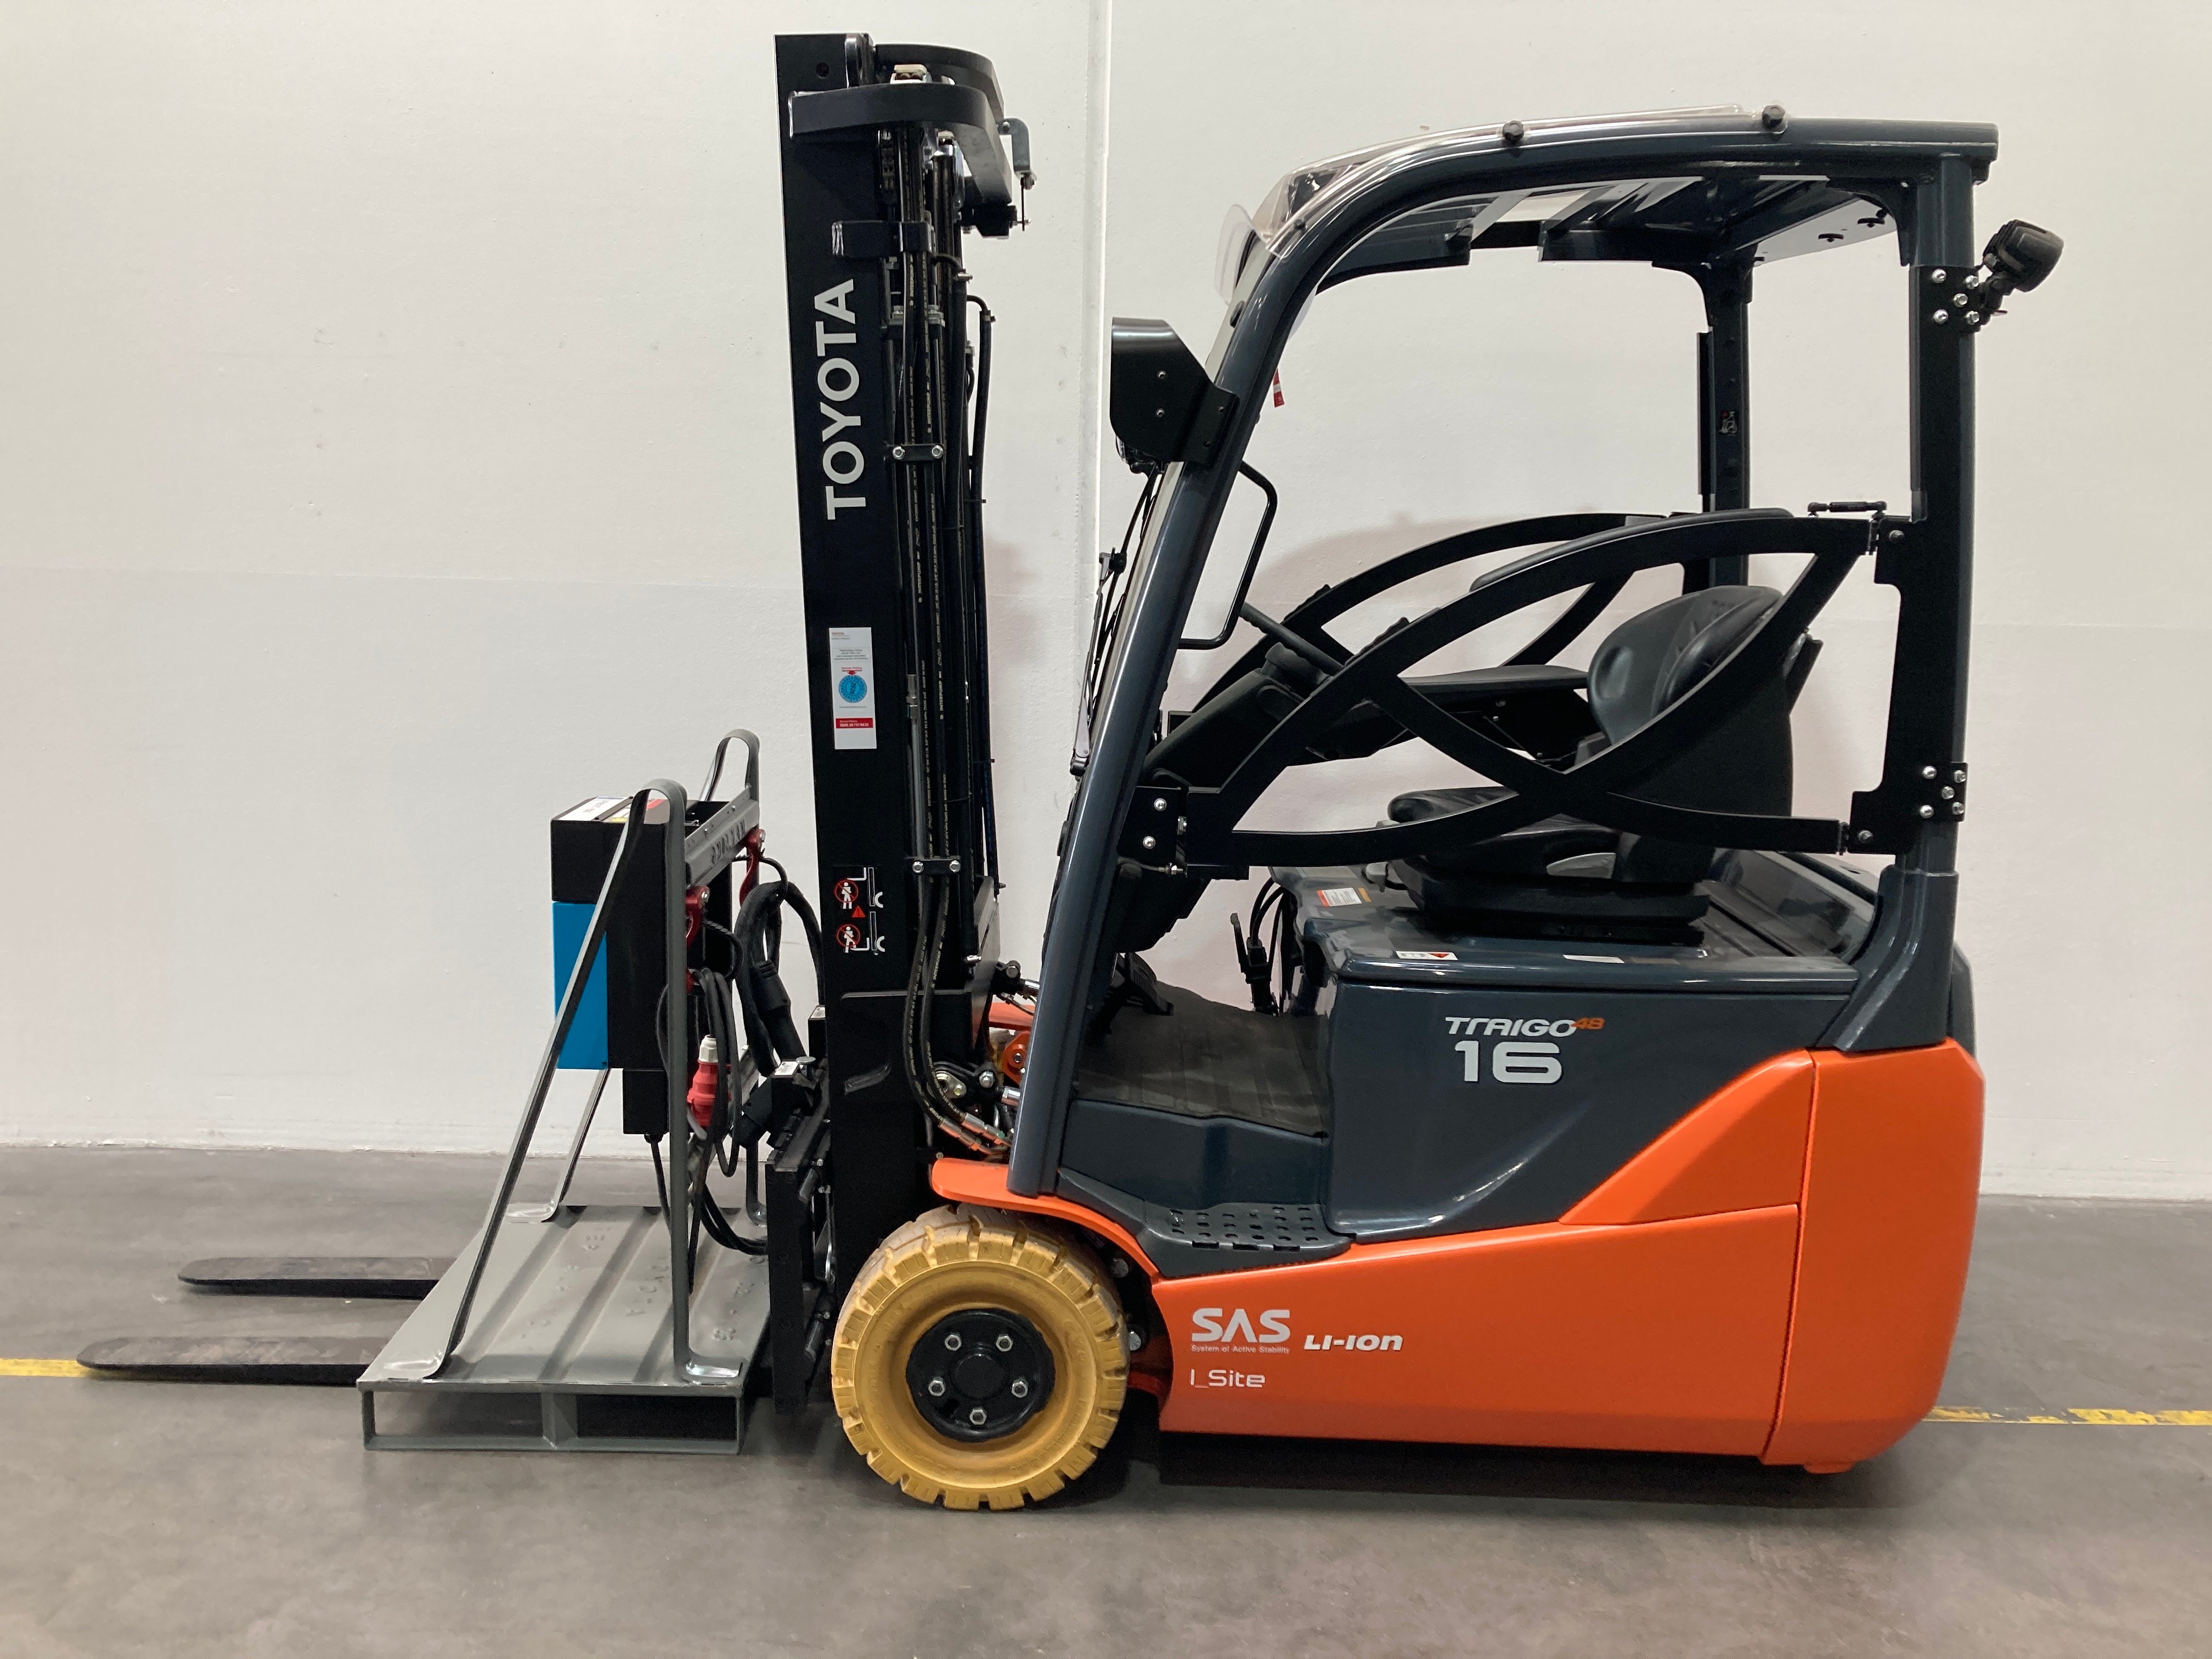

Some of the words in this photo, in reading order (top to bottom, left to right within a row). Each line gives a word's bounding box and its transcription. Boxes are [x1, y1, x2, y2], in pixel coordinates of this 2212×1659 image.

[814, 279, 866, 520] TOYOTA
[1455, 1040, 1562, 1084] 16
[1192, 1308, 1290, 1343] SAS
[1259, 1345, 1290, 1355] Stability
